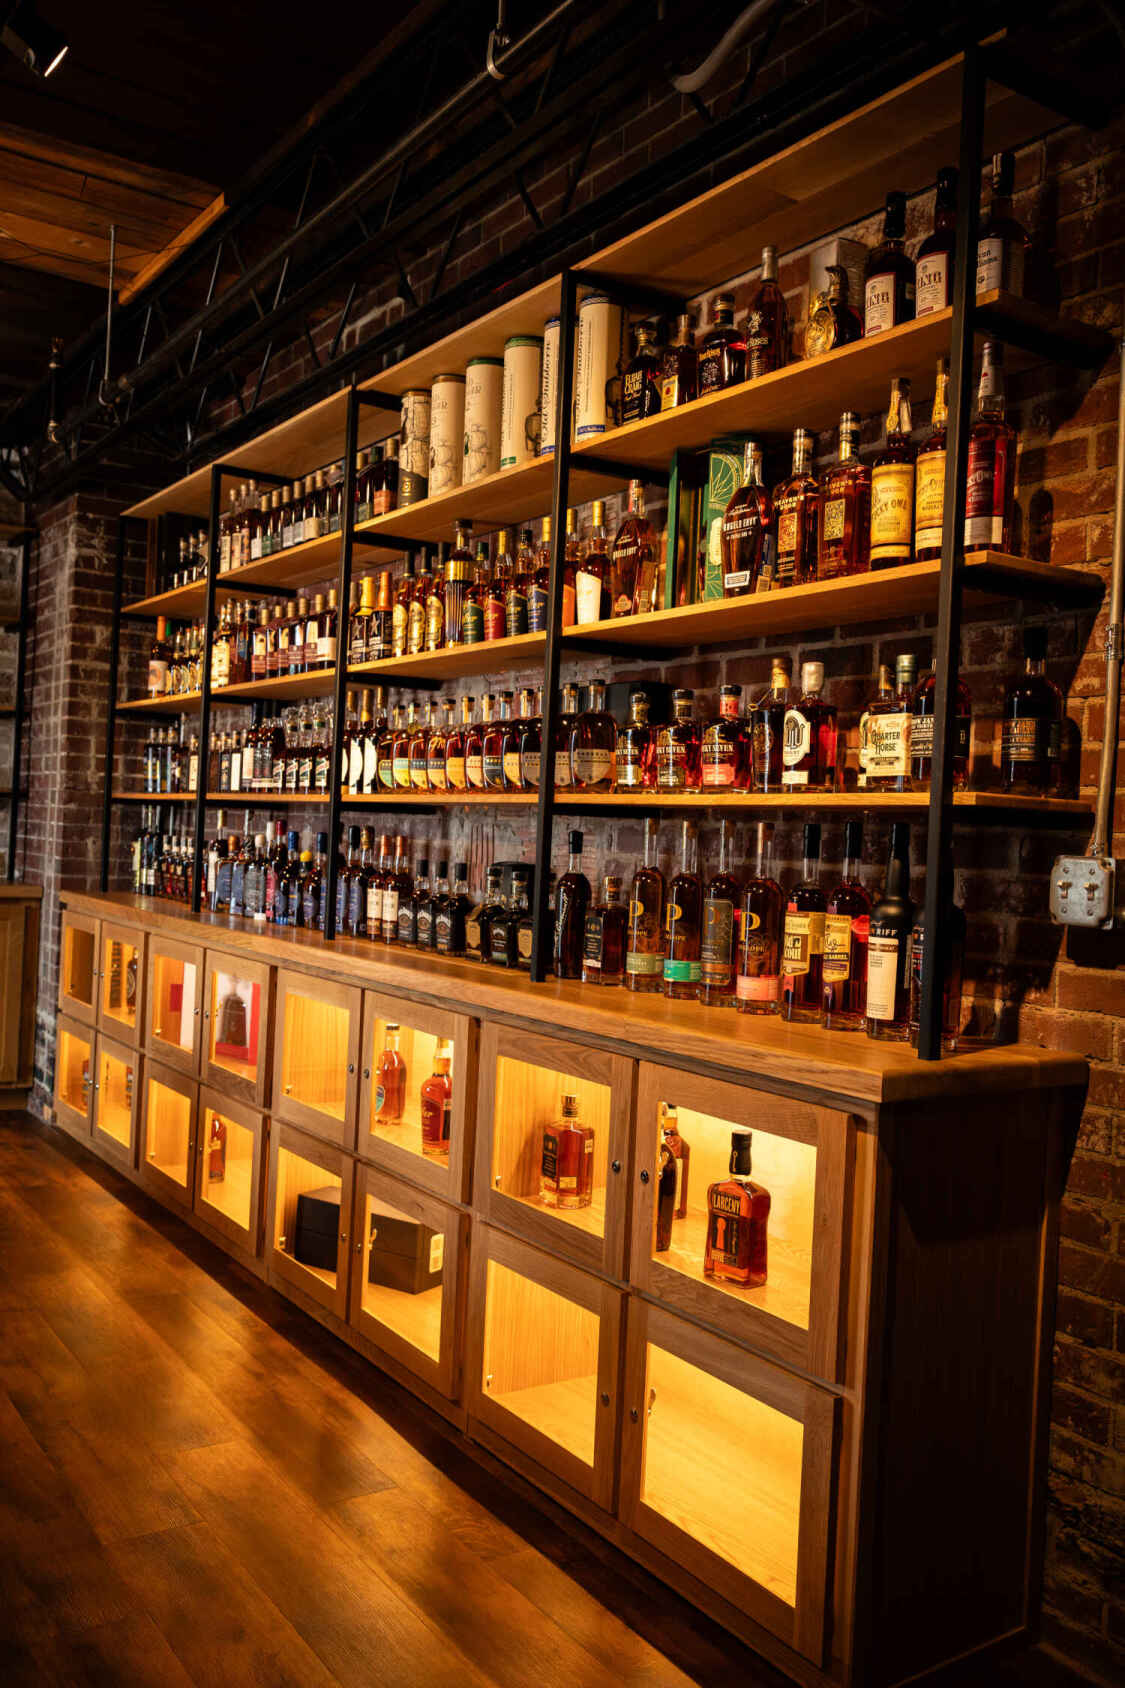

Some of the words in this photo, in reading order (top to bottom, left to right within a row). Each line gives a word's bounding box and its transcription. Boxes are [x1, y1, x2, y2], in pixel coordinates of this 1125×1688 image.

[871, 730, 900, 744] QUARTER
[875, 743, 897, 754] HORSE
[628, 900, 644, 928] P
[665, 903, 683, 931] P
[739, 911, 761, 942] P
[713, 1193, 741, 1216] LARCENY
